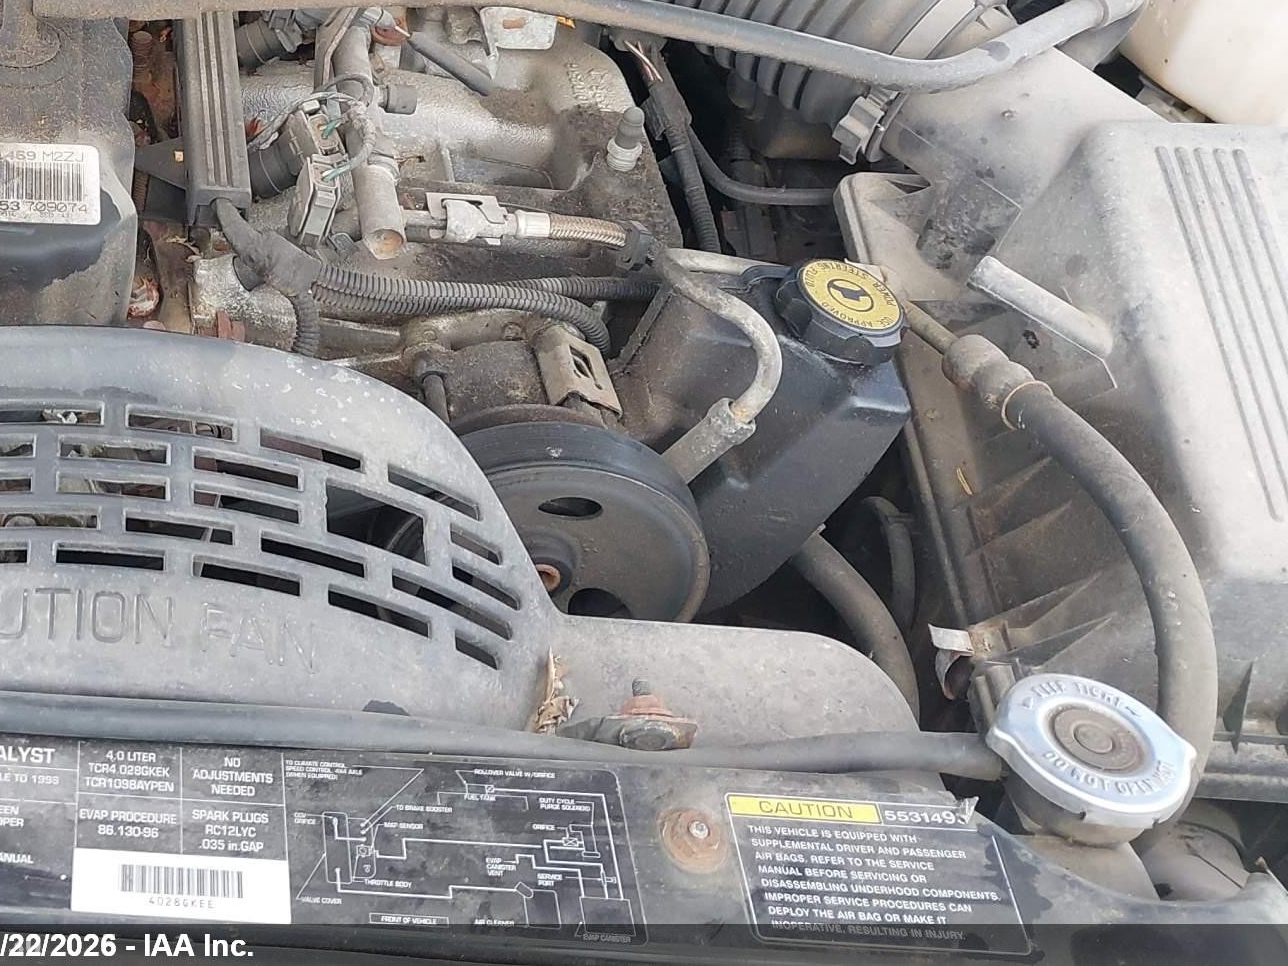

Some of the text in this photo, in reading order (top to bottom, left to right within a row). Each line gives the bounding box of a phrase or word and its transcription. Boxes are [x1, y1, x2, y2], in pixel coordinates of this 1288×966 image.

[200, 601, 318, 674] FAN
[105, 750, 157, 763] 4.0 LITER
[223, 757, 242, 768] NO
[192, 769, 274, 784] ADJUSTMENTS
[211, 784, 256, 797] NEEDED
[79, 808, 178, 825] EVAP PROCEDURE
[191, 809, 270, 824] SPARK PLUGS
[426, 806, 453, 815] BOOSTER
[758, 799, 853, 819] CAUTION
[205, 824, 257, 838] RC12LYC
[747, 824, 918, 844] THIS VEHICLE IS EQUIPPED WITH
[198, 838, 226, 851] .035
[750, 837, 968, 860] SUPPLEMENTAL DRIVER AND PASSENGER
[754, 851, 775, 861] AIR
[810, 855, 846, 866] REFER
[846, 857, 863, 867] TO
[864, 858, 888, 869] THE
[888, 860, 936, 871] SERVICE
[758, 864, 928, 883] MANUAL BEFORE SERVICING OR
[364, 878, 413, 890] THROTTLE BODY
[760, 877, 849, 893] DISASSEMBLING
[850, 883, 920, 897] UNDERHOOD
[764, 891, 974, 913] IMPROPER SERVICE PROCEDURES CAN
[380, 913, 402, 923] FRONT
[413, 916, 438, 926] VEHICLE
[767, 905, 948, 926] DEPLOY THE AIR BAG OR MAKE IT
